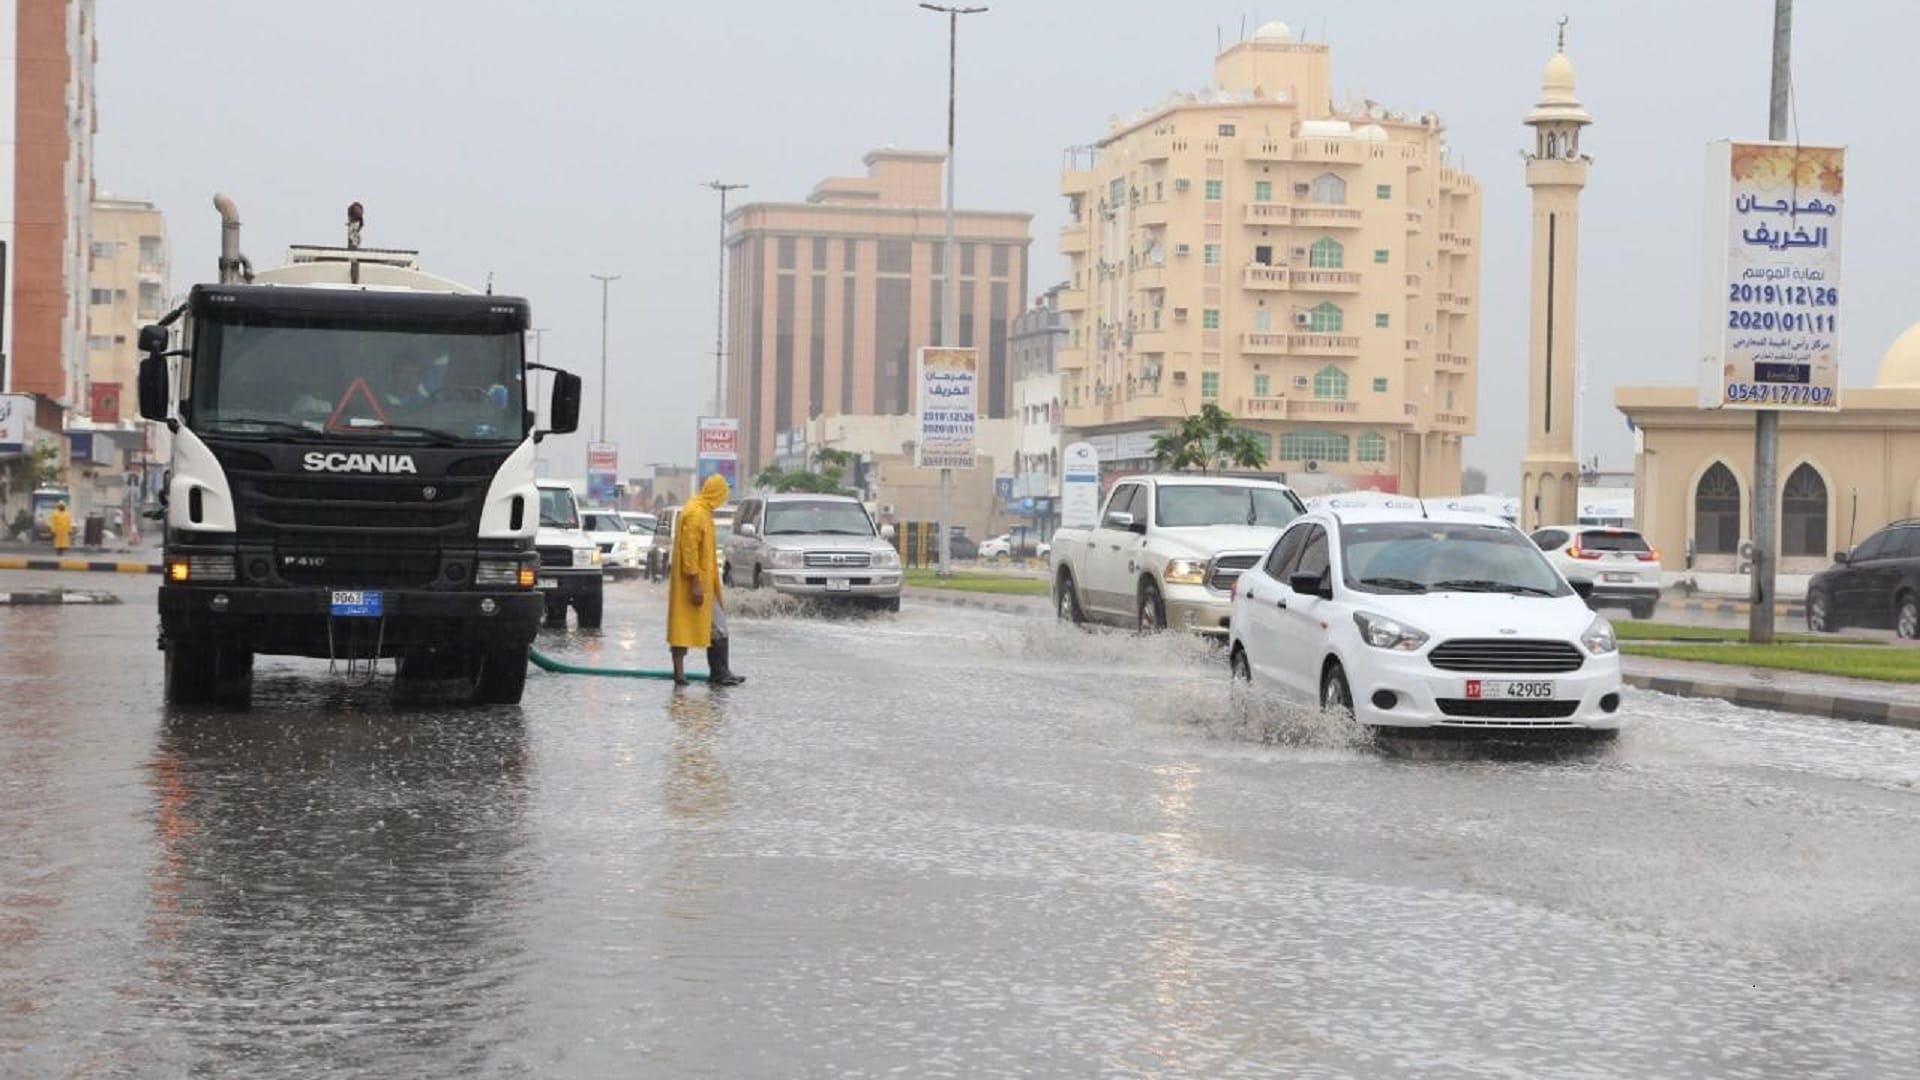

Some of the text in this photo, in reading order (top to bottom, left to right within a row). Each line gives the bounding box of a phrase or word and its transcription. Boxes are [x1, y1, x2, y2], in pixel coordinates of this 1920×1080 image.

[1736, 193, 1836, 216] مهرجان
[1743, 221, 1827, 250] الخريف
[1727, 383, 1833, 404] 0547177707
[302, 451, 417, 474] SCANIA
[284, 556, 295, 566] P
[1467, 684, 1480, 695] 17
[1507, 682, 1551, 697] 42905
